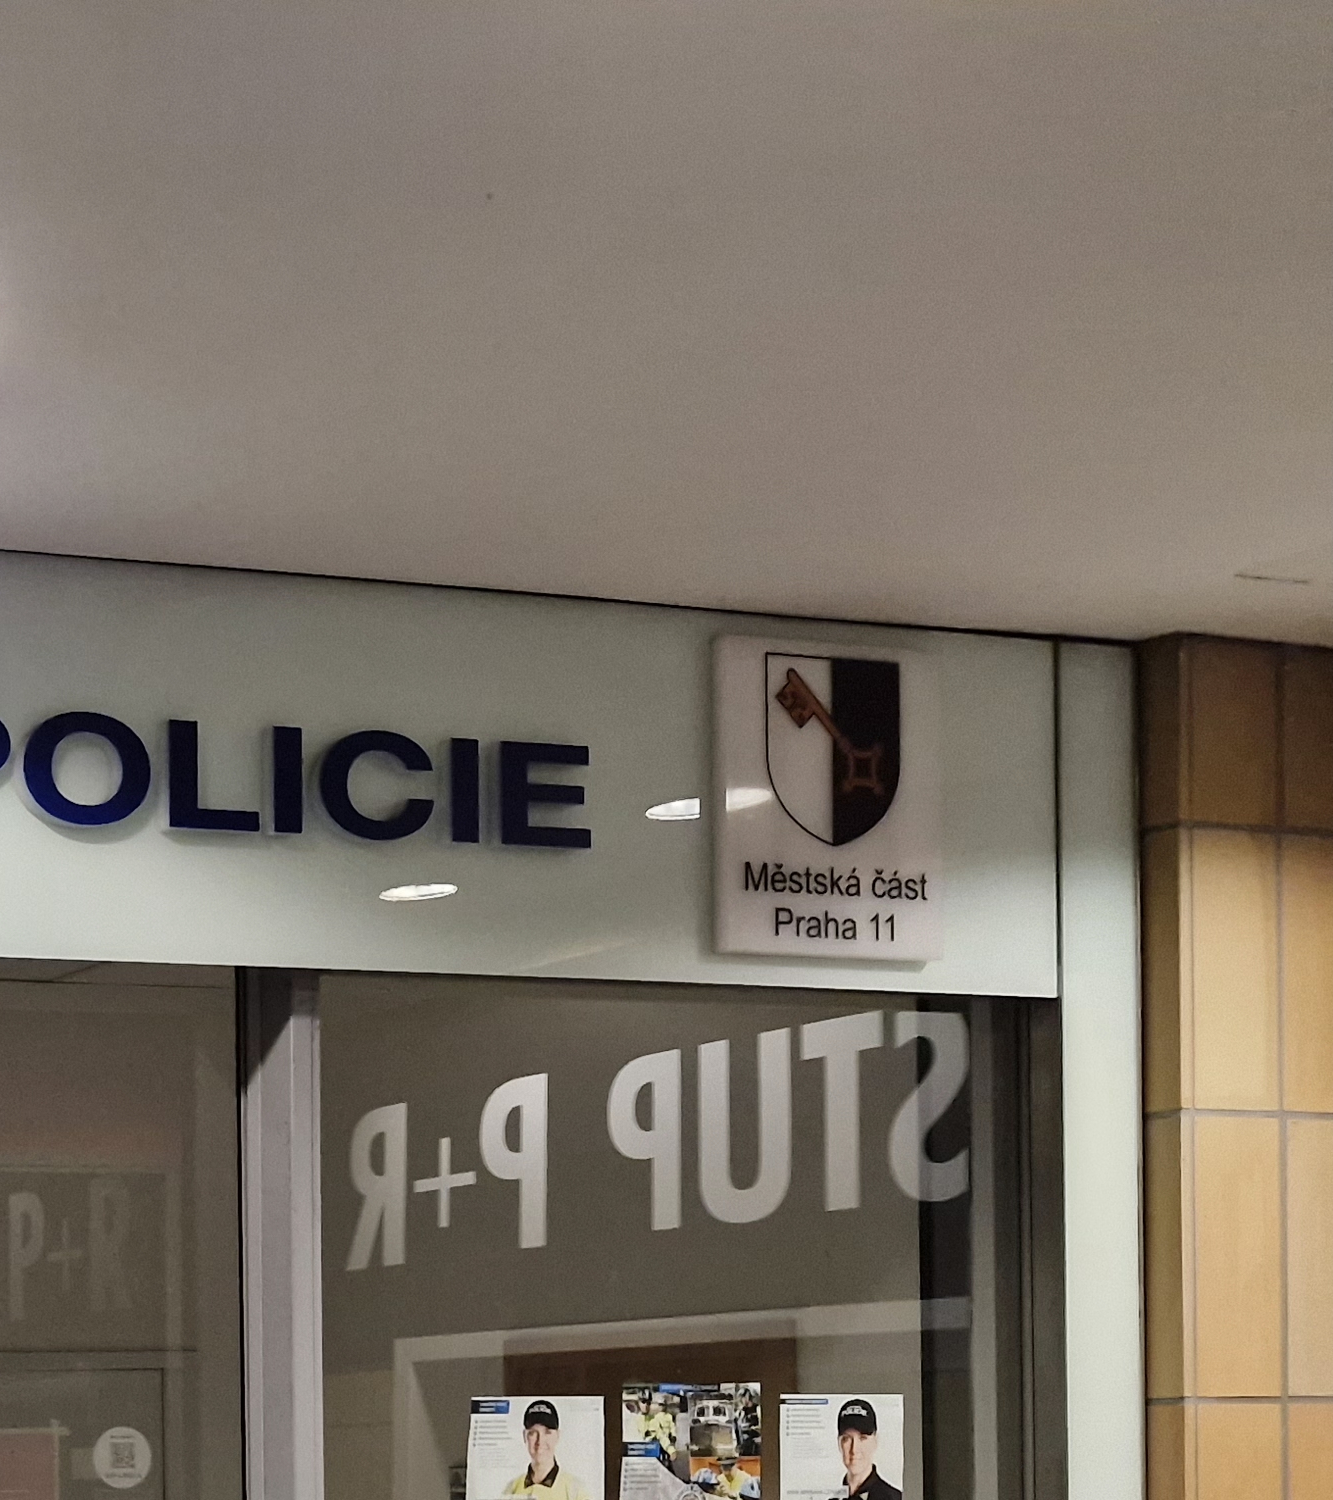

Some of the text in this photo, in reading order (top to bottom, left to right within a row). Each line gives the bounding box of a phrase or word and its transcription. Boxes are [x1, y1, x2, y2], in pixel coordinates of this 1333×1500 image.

[744, 861, 928, 900] Městská část
[774, 907, 895, 942] Praha 11
[8, 1178, 131, 1322] P+R
